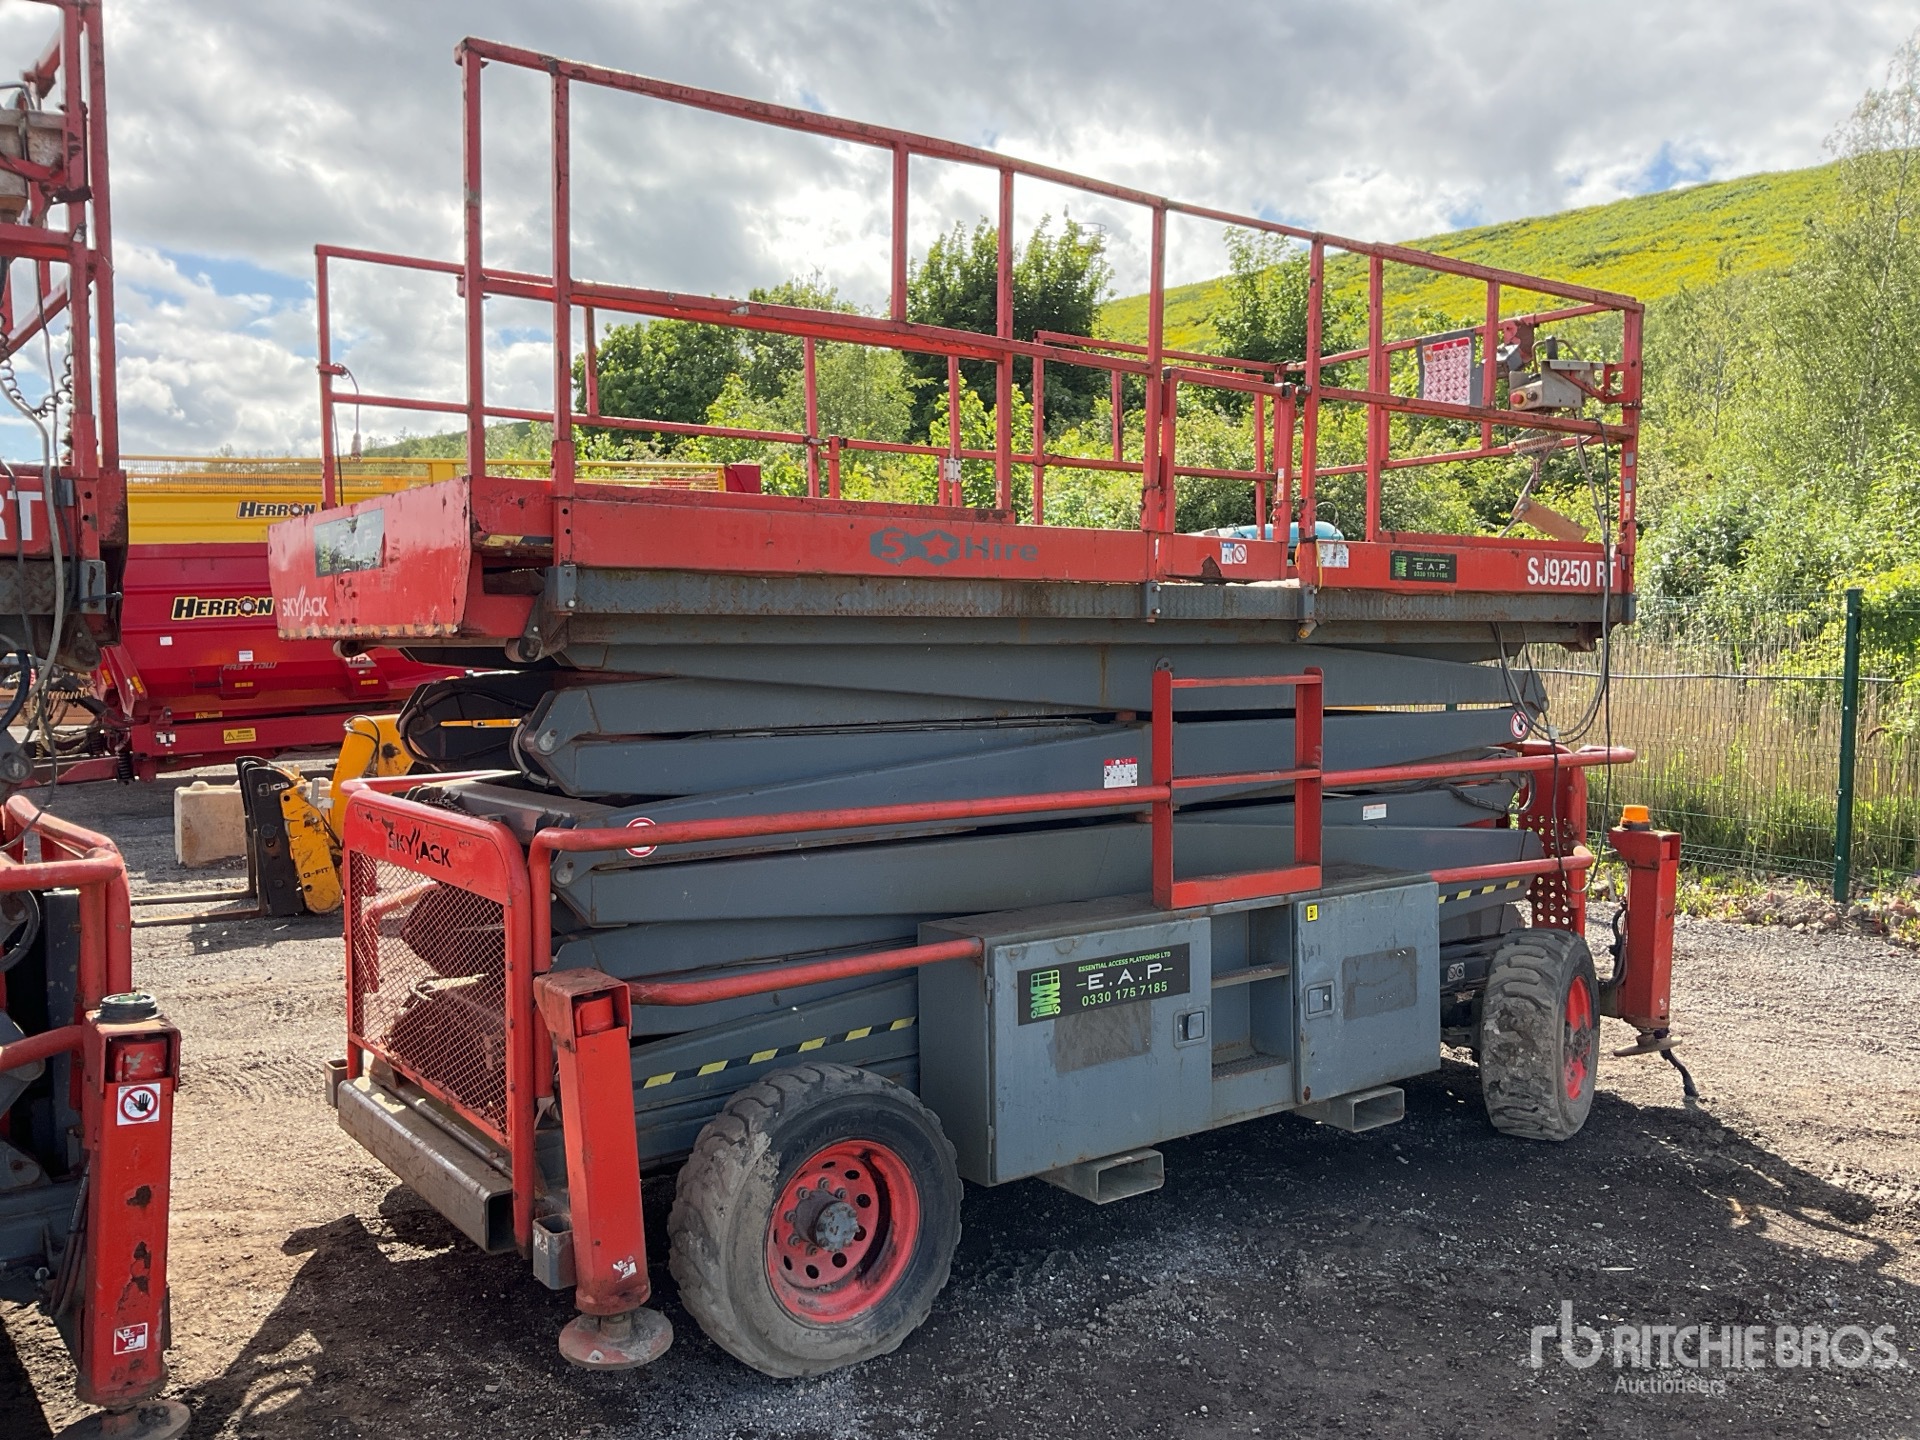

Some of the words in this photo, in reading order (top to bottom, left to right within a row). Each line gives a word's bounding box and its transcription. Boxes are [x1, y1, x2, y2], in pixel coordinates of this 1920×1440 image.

[0, 489, 43, 541] T
[237, 501, 317, 518] HERRON
[965, 535, 1038, 561] Hire
[1527, 557, 1591, 587] SJ9250
[172, 597, 274, 619] HERRON
[282, 586, 330, 622] SKYJACK
[388, 827, 452, 868] SKYJACK
[303, 866, 330, 879] Q-FIT
[1078, 962, 1108, 973] ESSENTIAL
[1108, 958, 1129, 968] ACCESS
[1129, 954, 1161, 965] PLATFORMS
[1160, 951, 1171, 959] LTD
[1082, 991, 1112, 1007] 0330
[1116, 987, 1137, 1000] 175
[1140, 981, 1168, 996] 7185
